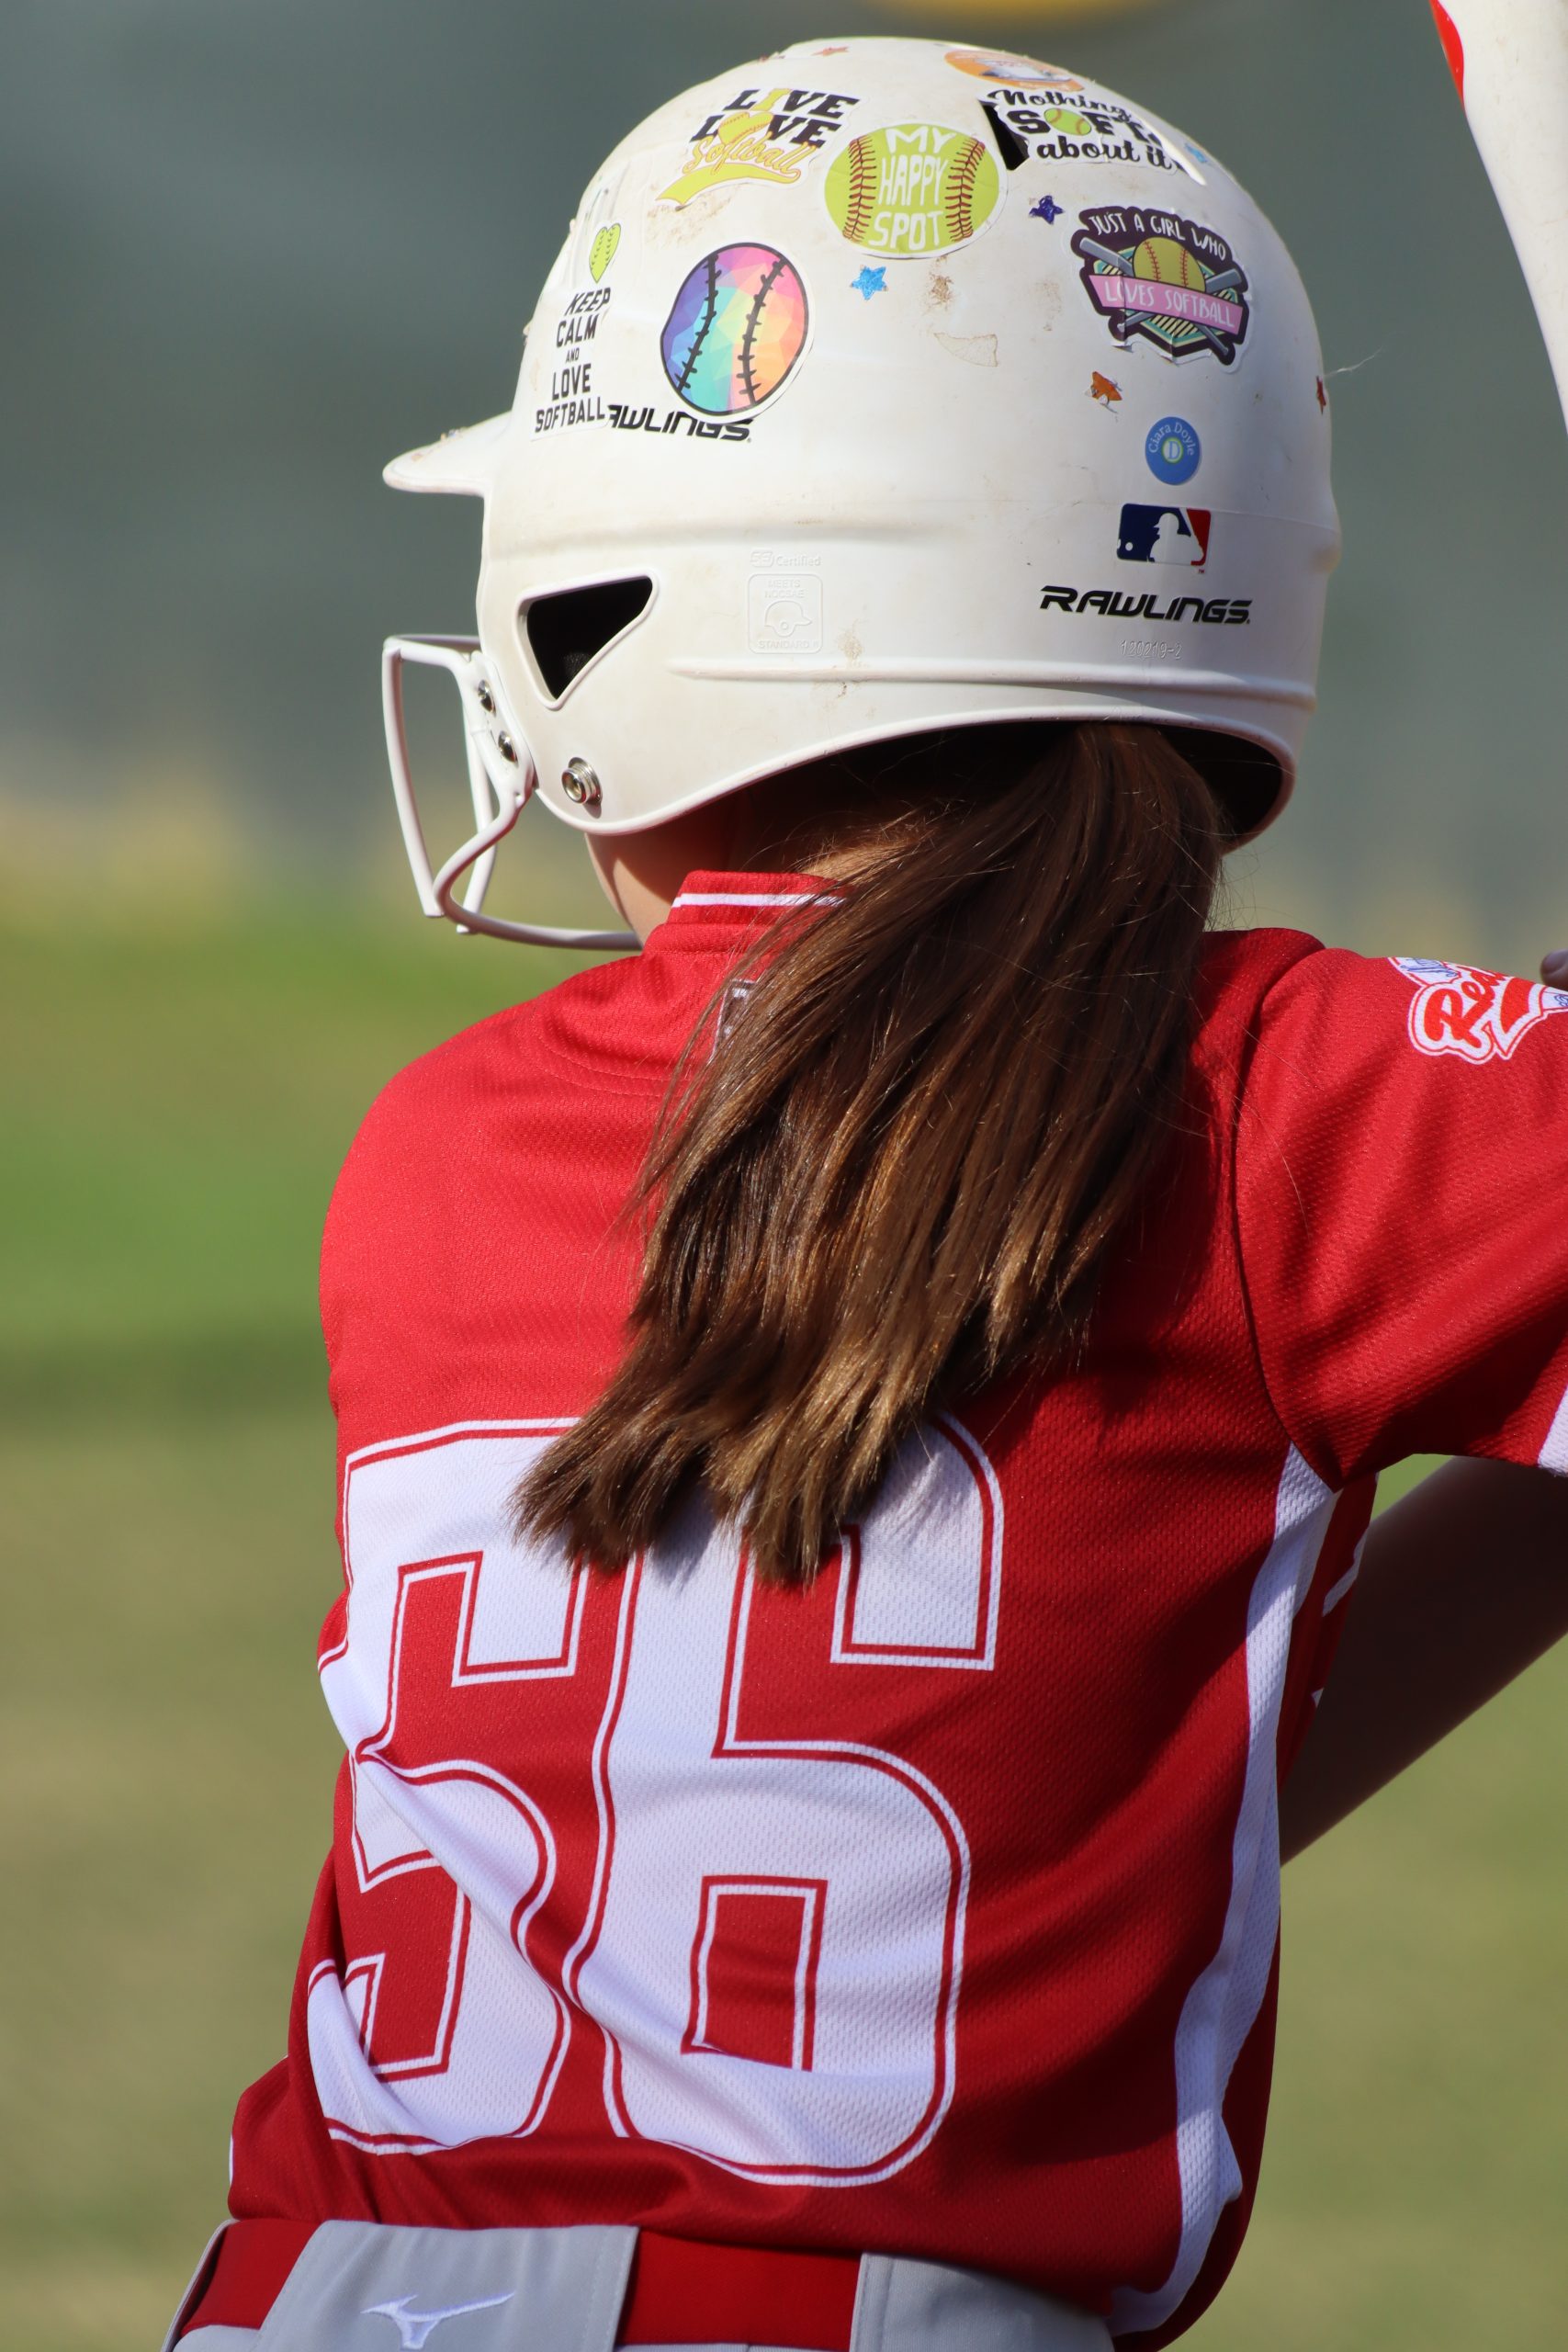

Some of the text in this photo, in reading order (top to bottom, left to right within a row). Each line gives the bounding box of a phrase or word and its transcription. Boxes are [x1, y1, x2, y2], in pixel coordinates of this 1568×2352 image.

[722, 88, 860, 119] LIVE
[987, 89, 1133, 123] Nothing
[682, 133, 817, 175] Softball
[885, 126, 956, 153] MY
[1036, 135, 1172, 170] about it
[877, 154, 948, 206] HAPPY
[867, 210, 943, 251] SPOT
[1089, 212, 1227, 261] JUST A GIRL WHO
[564, 287, 611, 316] KEEP
[1104, 279, 1235, 328] LOVES SOFTBALL
[556, 313, 600, 348] CALM
[566, 347, 580, 363] AND
[551, 363, 592, 401] LOVE
[535, 396, 605, 434] SOFTBALL
[1148, 422, 1196, 456] Ciara Doyle
[1168, 440, 1181, 459] D
[1040, 585, 1253, 625] RAWLINGS
